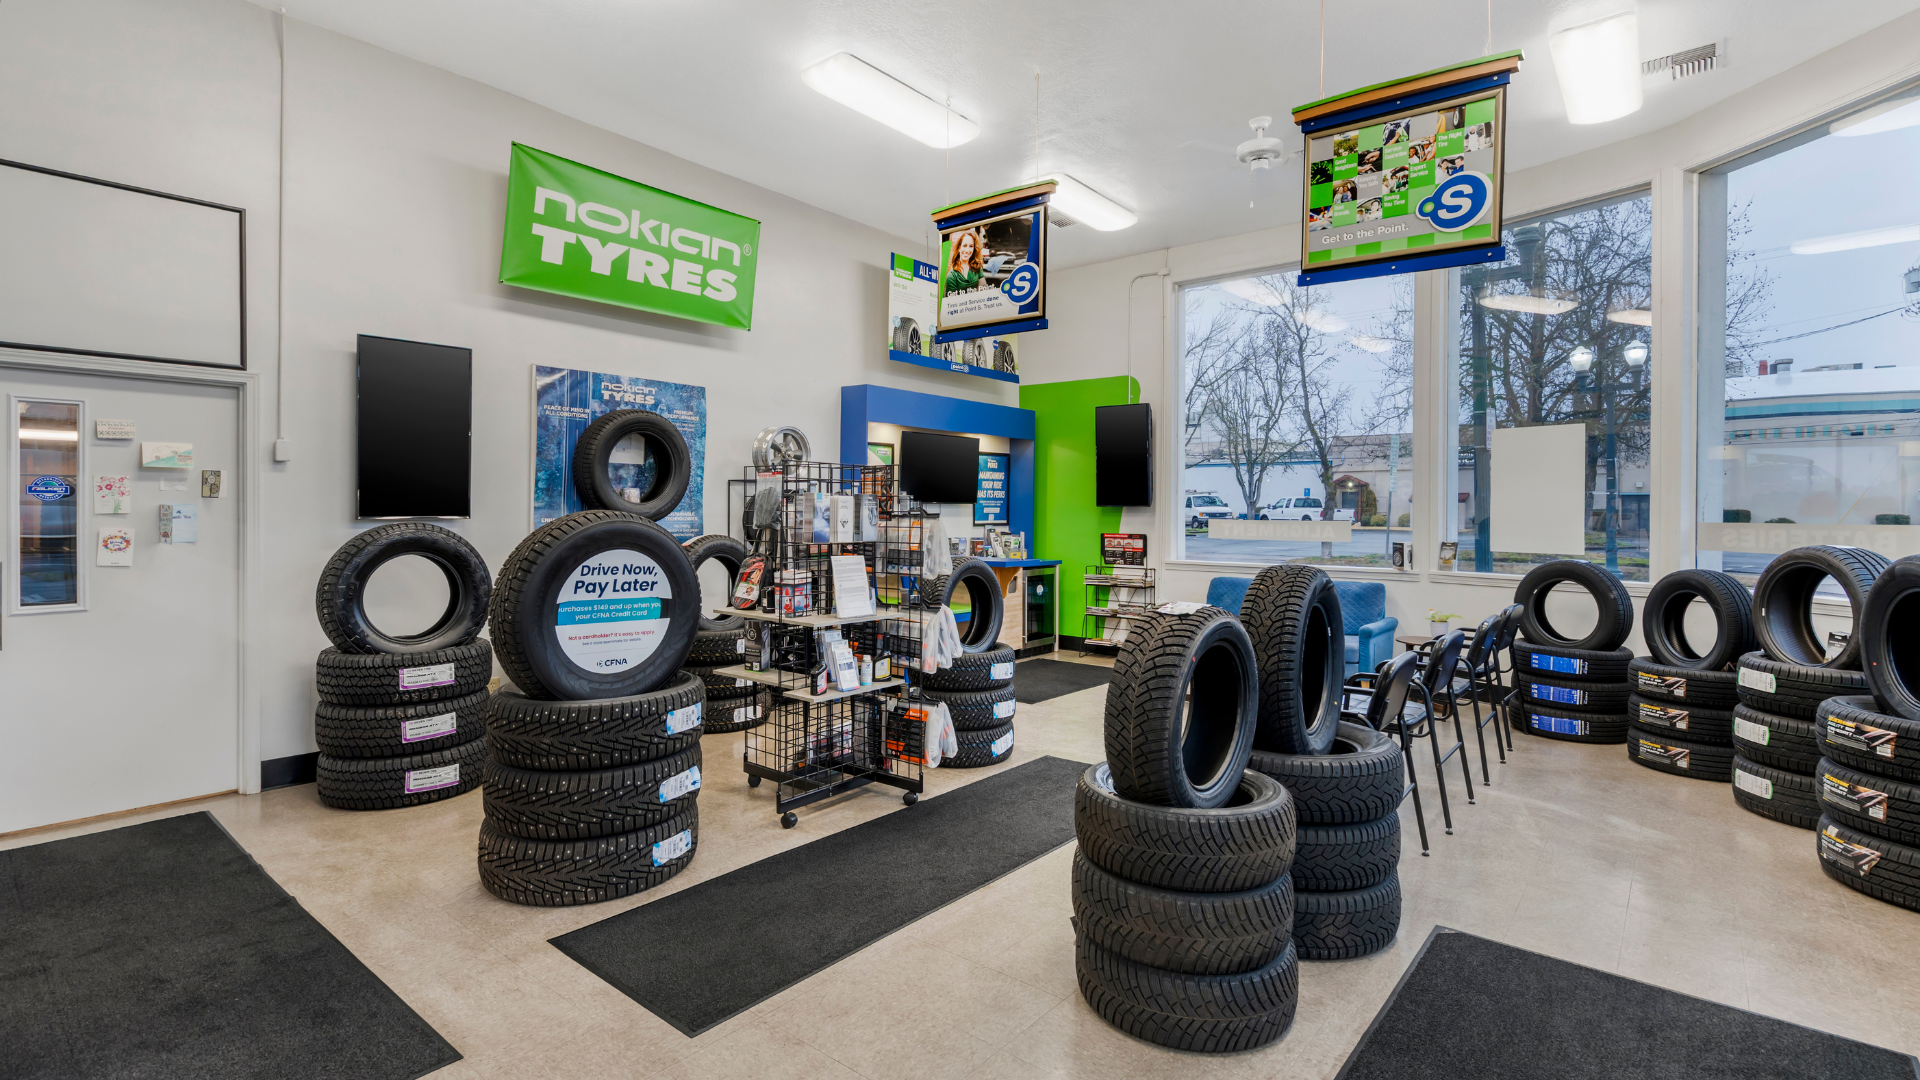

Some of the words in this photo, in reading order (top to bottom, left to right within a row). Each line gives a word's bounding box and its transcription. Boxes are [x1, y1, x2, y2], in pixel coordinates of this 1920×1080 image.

[1449, 131, 1462, 139] Right
[1384, 145, 1402, 154] Service
[1384, 150, 1407, 160] Guarantee
[1335, 162, 1357, 172] Neighbors
[1410, 163, 1426, 172] Expert
[1410, 170, 1428, 178] Service
[1384, 194, 1399, 202] Saving
[1437, 184, 1473, 220] S
[1334, 209, 1350, 217] Brands
[1322, 233, 1341, 244] Get
[1343, 231, 1354, 240] to
[1357, 228, 1375, 239] the
[1378, 222, 1409, 236] Point.
[531, 222, 738, 302] TYRES
[967, 286, 978, 294] the
[978, 283, 997, 291] Point.
[1011, 271, 1031, 297] S
[968, 298, 985, 306] Service
[601, 390, 655, 405] TYRES
[556, 411, 588, 419] CONDITIONS
[667, 413, 699, 421] PERFORMANCE
[977, 490, 987, 498] HAS
[994, 490, 1005, 498] PERKS
[580, 562, 619, 577] Drive
[622, 562, 658, 578] Now,
[573, 579, 611, 598] Pay
[613, 577, 658, 593] Later
[593, 603, 608, 611] $149
[624, 603, 633, 611] up
[575, 613, 591, 621] your
[611, 610, 631, 618] Credit
[582, 632, 613, 640] cardholder?
[604, 658, 628, 667] CFNA
